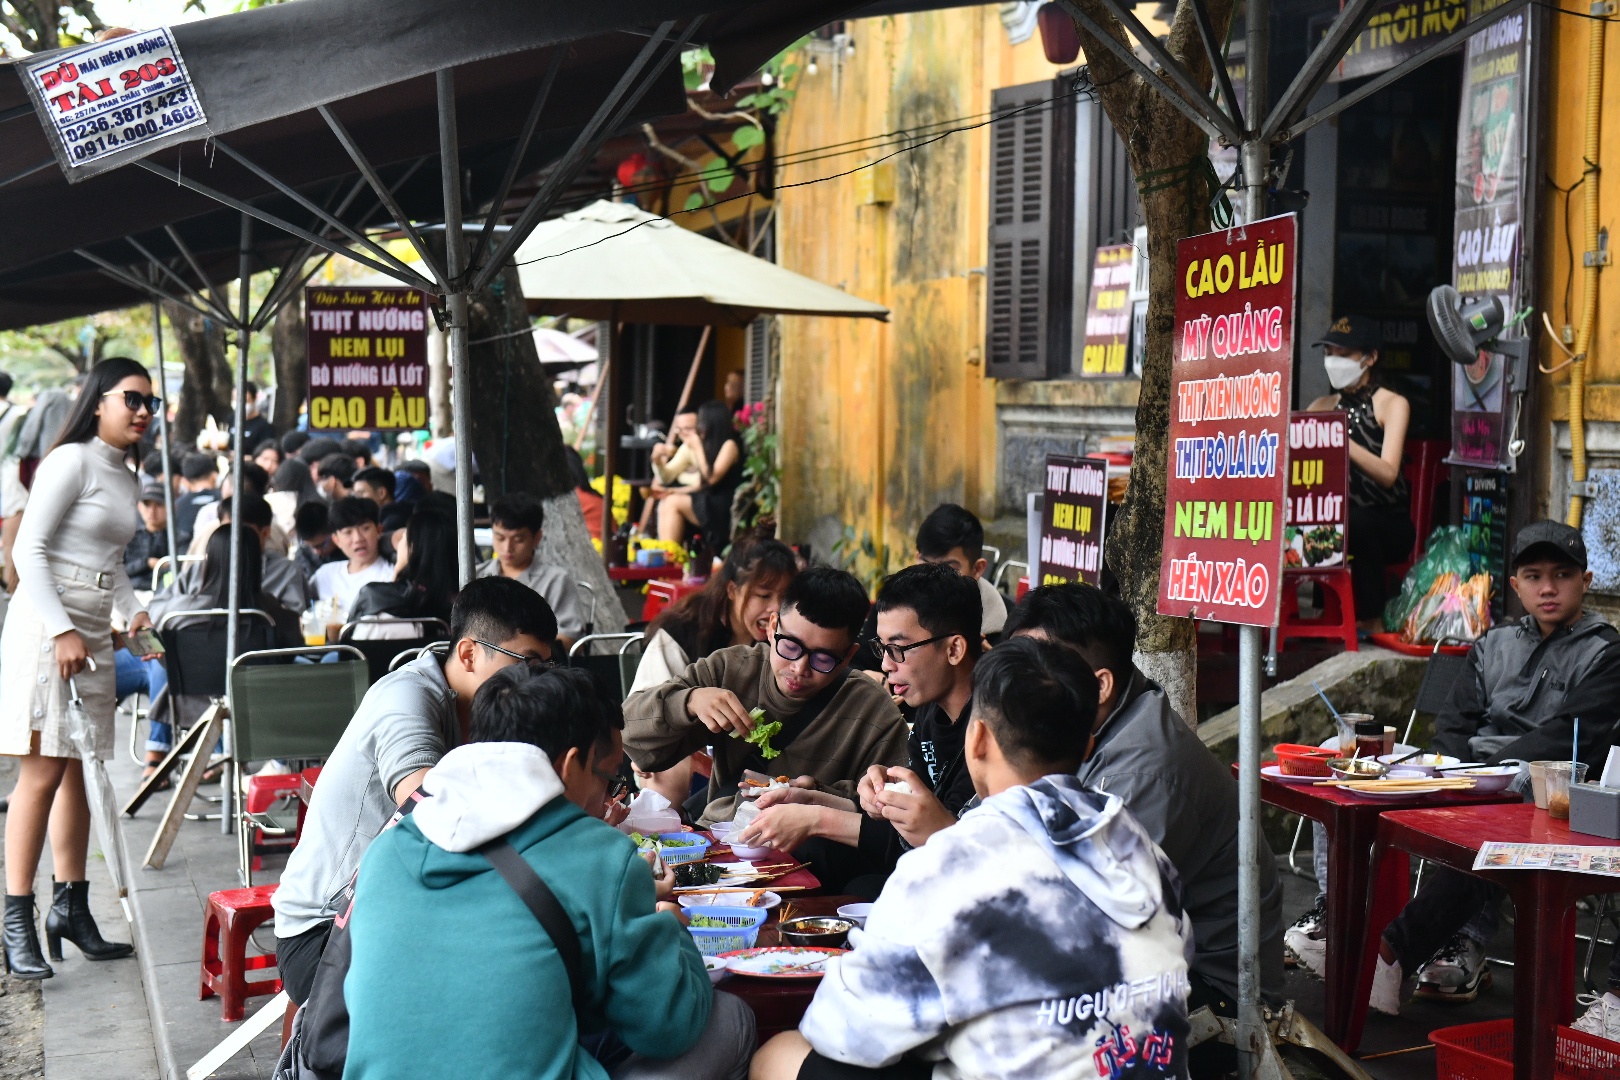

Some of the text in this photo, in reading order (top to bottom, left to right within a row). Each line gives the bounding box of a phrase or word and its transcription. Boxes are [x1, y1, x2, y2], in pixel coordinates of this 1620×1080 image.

[40, 36, 167, 91] DÙ MÁI HIÊN DI ĐỘNG
[50, 57, 177, 114] TÀI 203
[75, 107, 97, 119] 257/4
[97, 98, 119, 111] PHAN
[120, 90, 141, 103] CHÂU
[66, 88, 188, 143] 0236.3873.423
[73, 105, 196, 160] 0914.000.460
[1458, 227, 1482, 267] CAO
[1185, 254, 1234, 299] CAO
[310, 307, 424, 335] THỊT NƯỚNG
[1181, 313, 1212, 362] MỲ
[1212, 301, 1283, 360] QUẢNG
[330, 337, 405, 361] NEM LỤI
[311, 363, 330, 386] BÒ
[333, 362, 379, 386] NƯỚNG
[381, 363, 397, 386] LÁ
[311, 387, 426, 429] CAO LẦU
[1178, 369, 1281, 426] THỊT XIÊN NƯỚNG
[1290, 418, 1344, 450] ƯỚNG
[1175, 436, 1205, 483] THỊT
[1204, 431, 1227, 480] BÒ
[1227, 430, 1247, 478] LÁ
[1292, 459, 1323, 490] LỤI
[1047, 464, 1104, 497] THỊT NƯỚNG
[1052, 502, 1092, 537] NEM LỤI
[1174, 501, 1228, 539] NEM
[1233, 501, 1274, 546] LỤI
[1296, 492, 1313, 523] LÁ
[1167, 552, 1269, 609] HẾN XÀO
